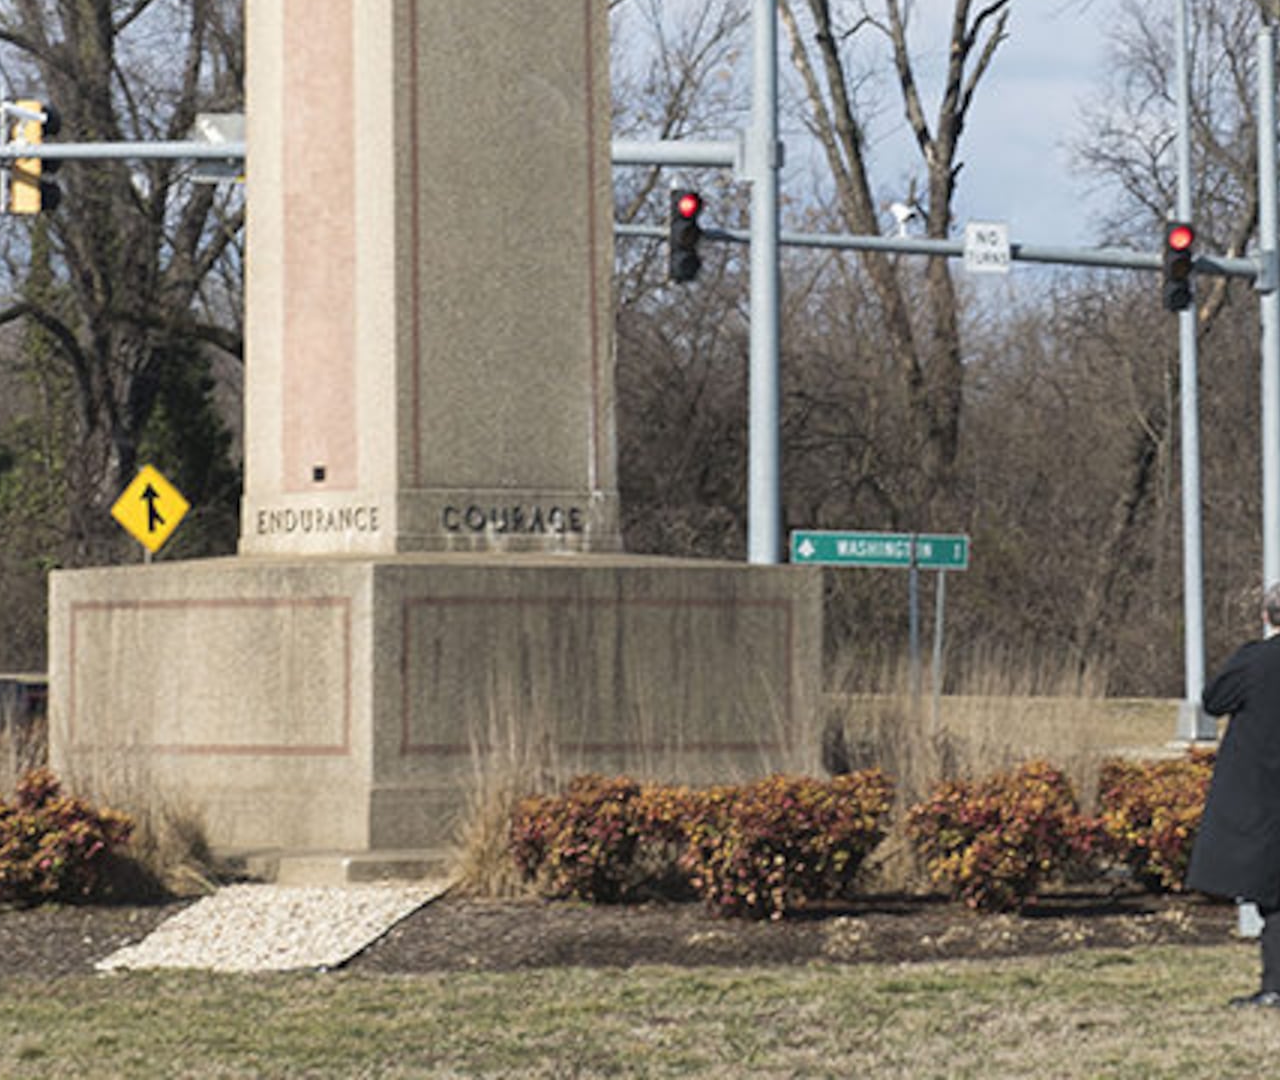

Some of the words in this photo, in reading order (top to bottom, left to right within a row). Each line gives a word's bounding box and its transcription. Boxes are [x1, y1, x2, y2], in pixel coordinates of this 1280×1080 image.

[976, 230, 998, 246] NO
[257, 506, 380, 534] ENDURANCE
[442, 505, 584, 533] COURAGE
